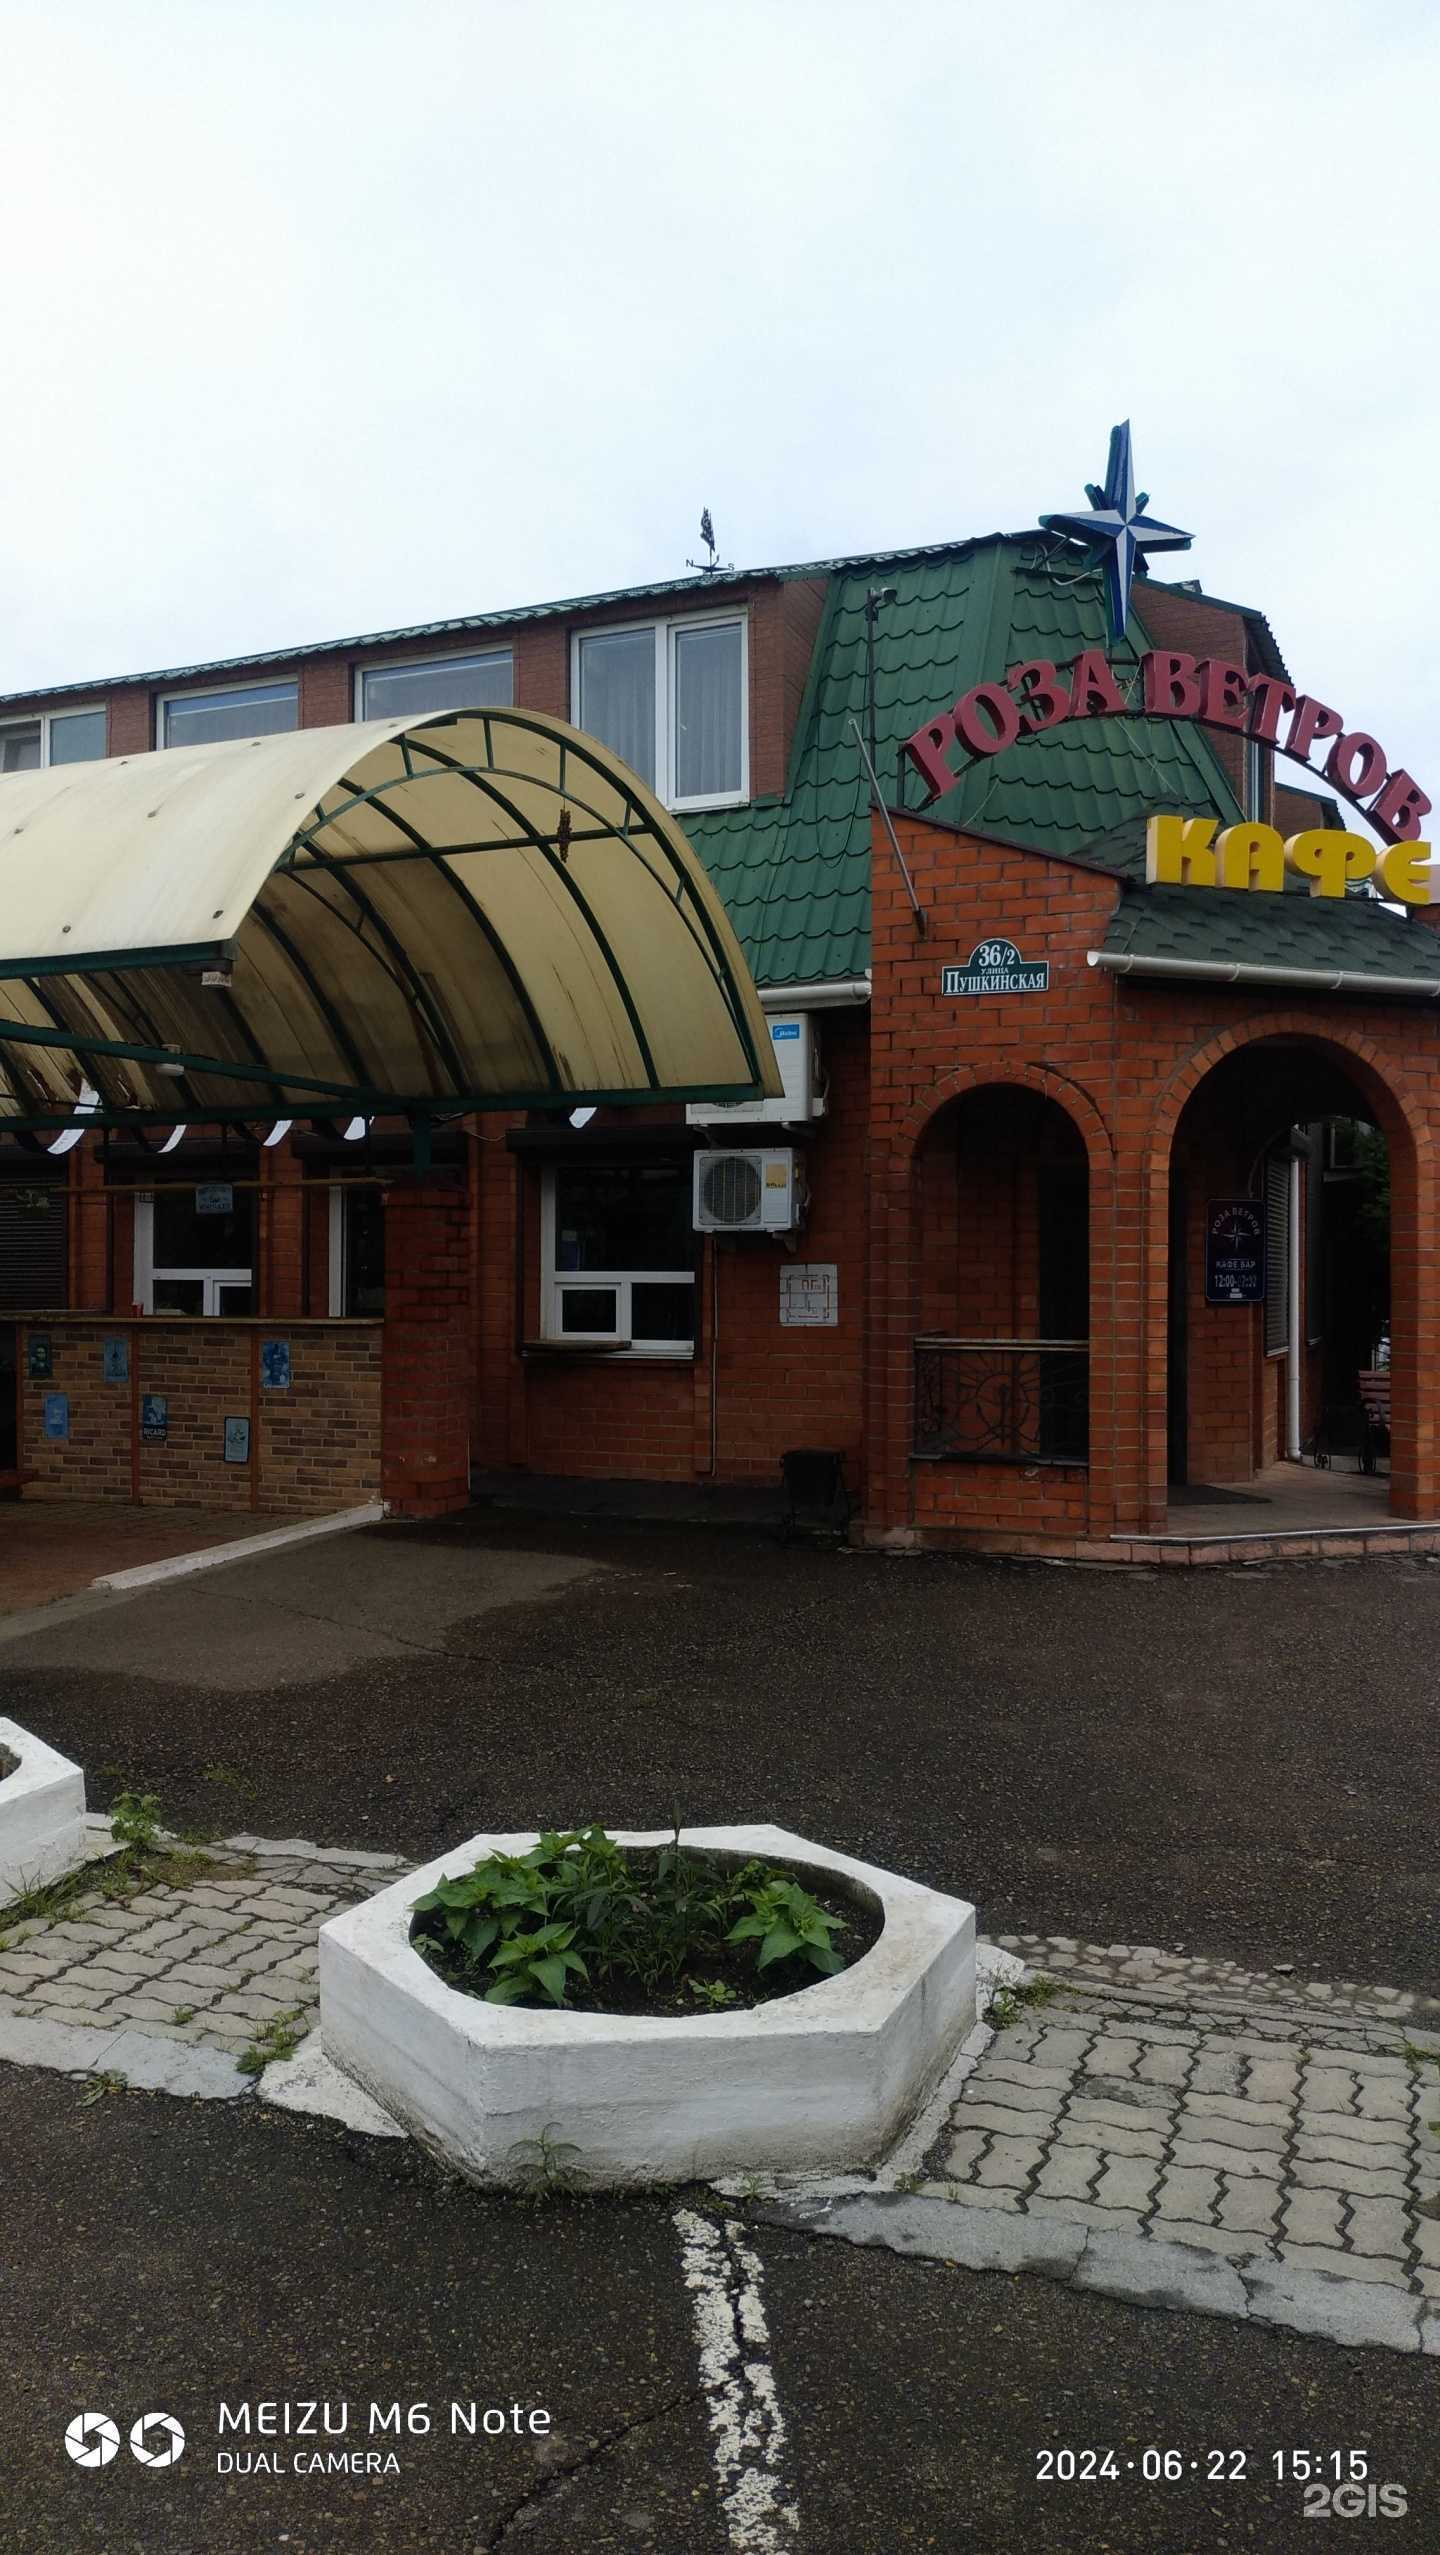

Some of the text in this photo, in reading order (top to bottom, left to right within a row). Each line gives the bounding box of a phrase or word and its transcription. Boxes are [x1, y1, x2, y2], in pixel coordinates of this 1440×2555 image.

[901, 649, 1432, 843] РОЗА ВЕТРОВ
[1145, 815, 1432, 904] КАФЕ
[978, 945, 1015, 967] 36/2
